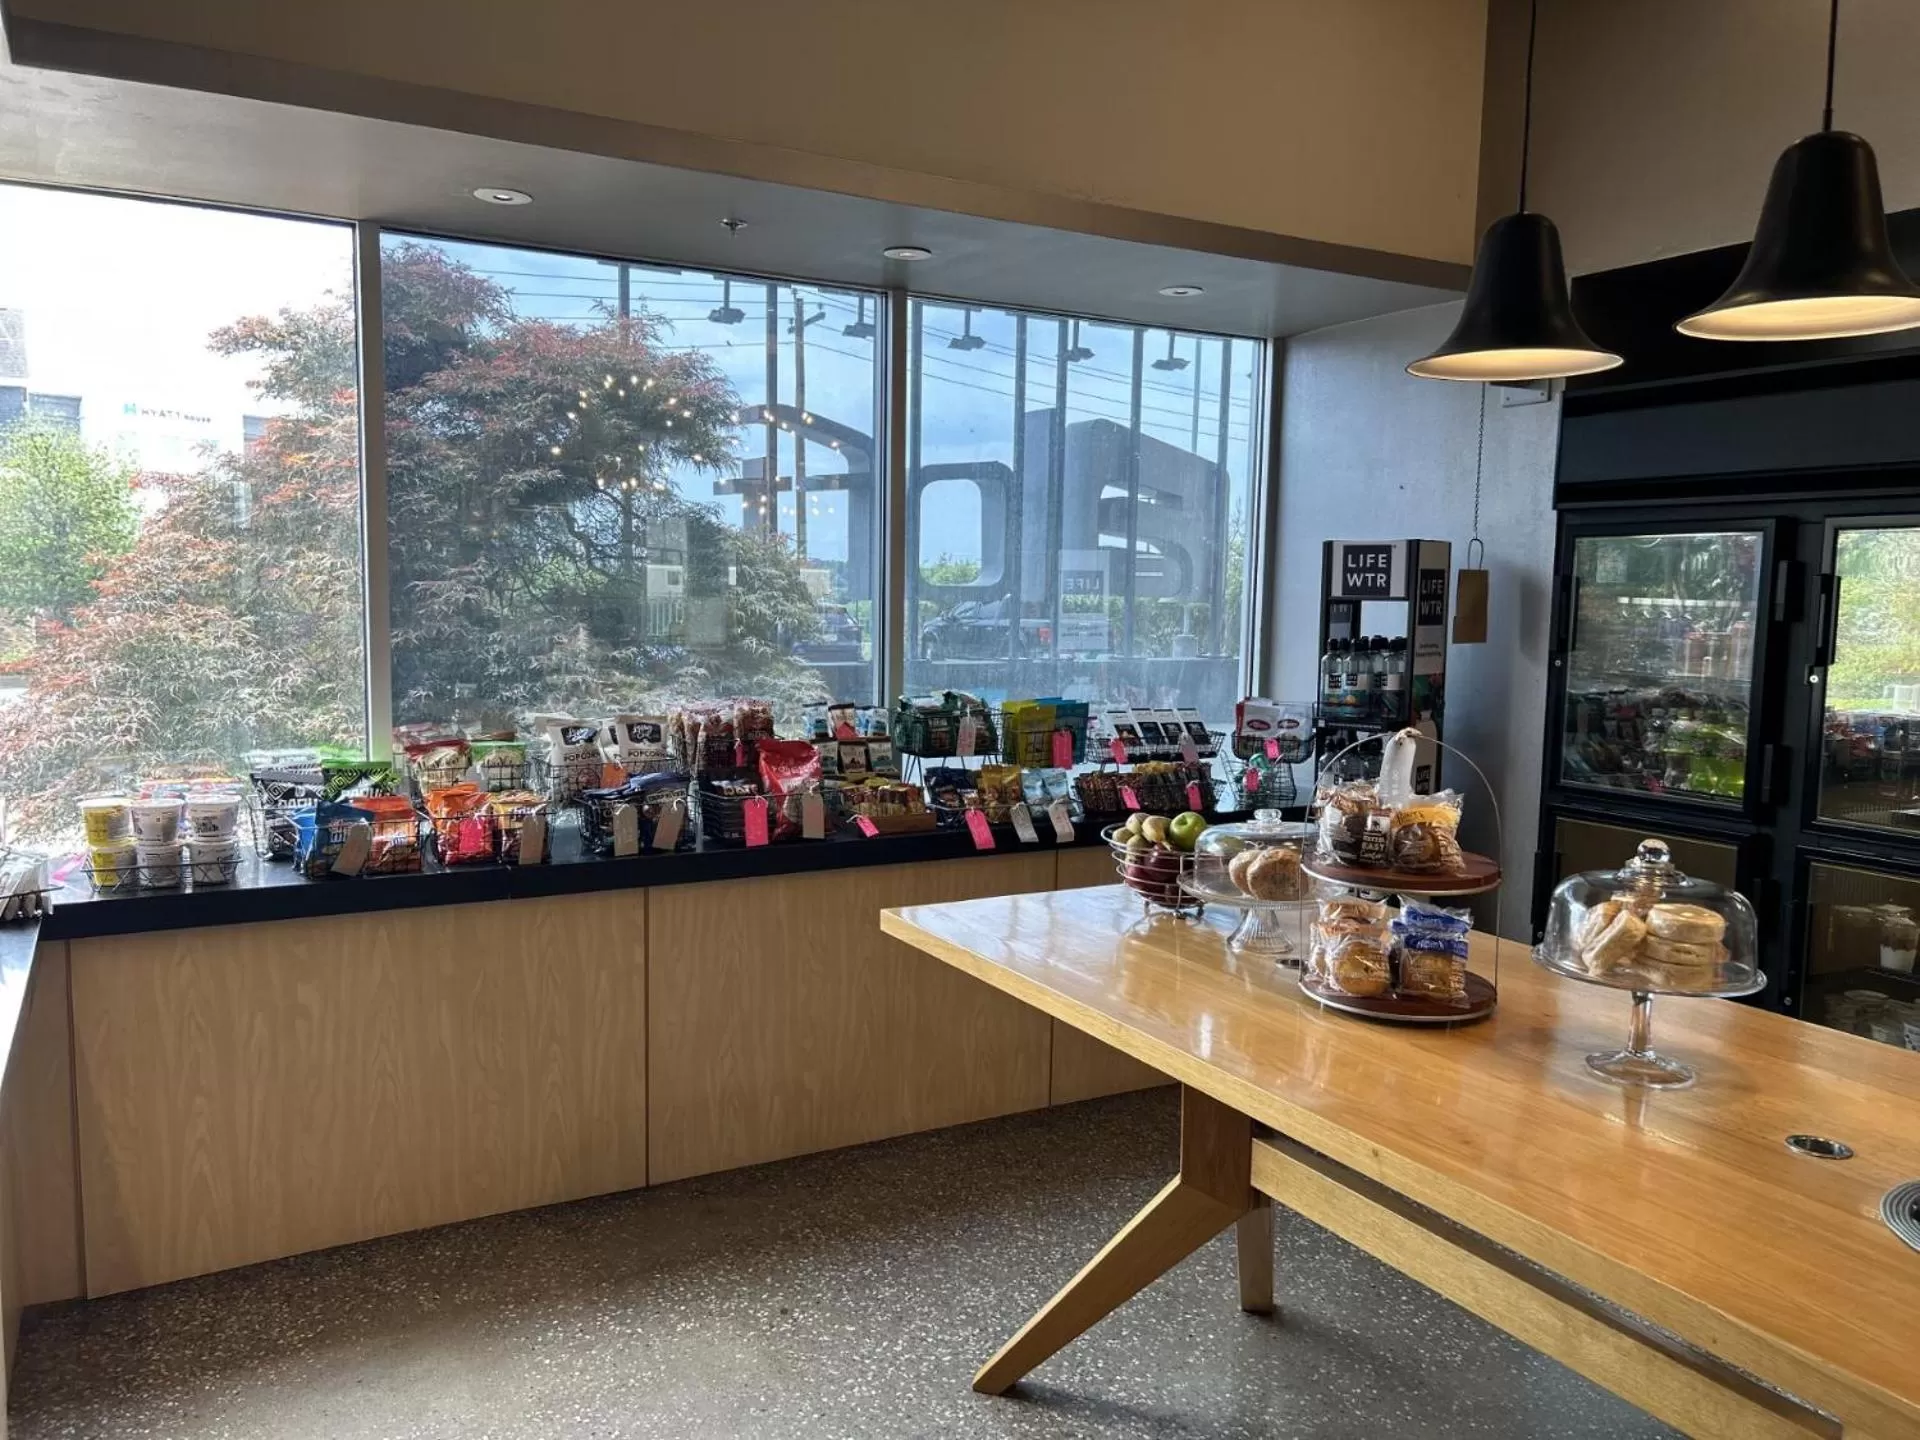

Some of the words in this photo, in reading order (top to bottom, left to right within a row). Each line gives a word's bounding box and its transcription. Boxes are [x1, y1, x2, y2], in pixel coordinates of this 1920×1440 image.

[141, 409, 181, 420] HYATT
[1347, 553, 1388, 568] LIFE
[1346, 572, 1387, 588] WTR
[1421, 579, 1444, 595] LIFE
[1420, 600, 1443, 616] WTR
